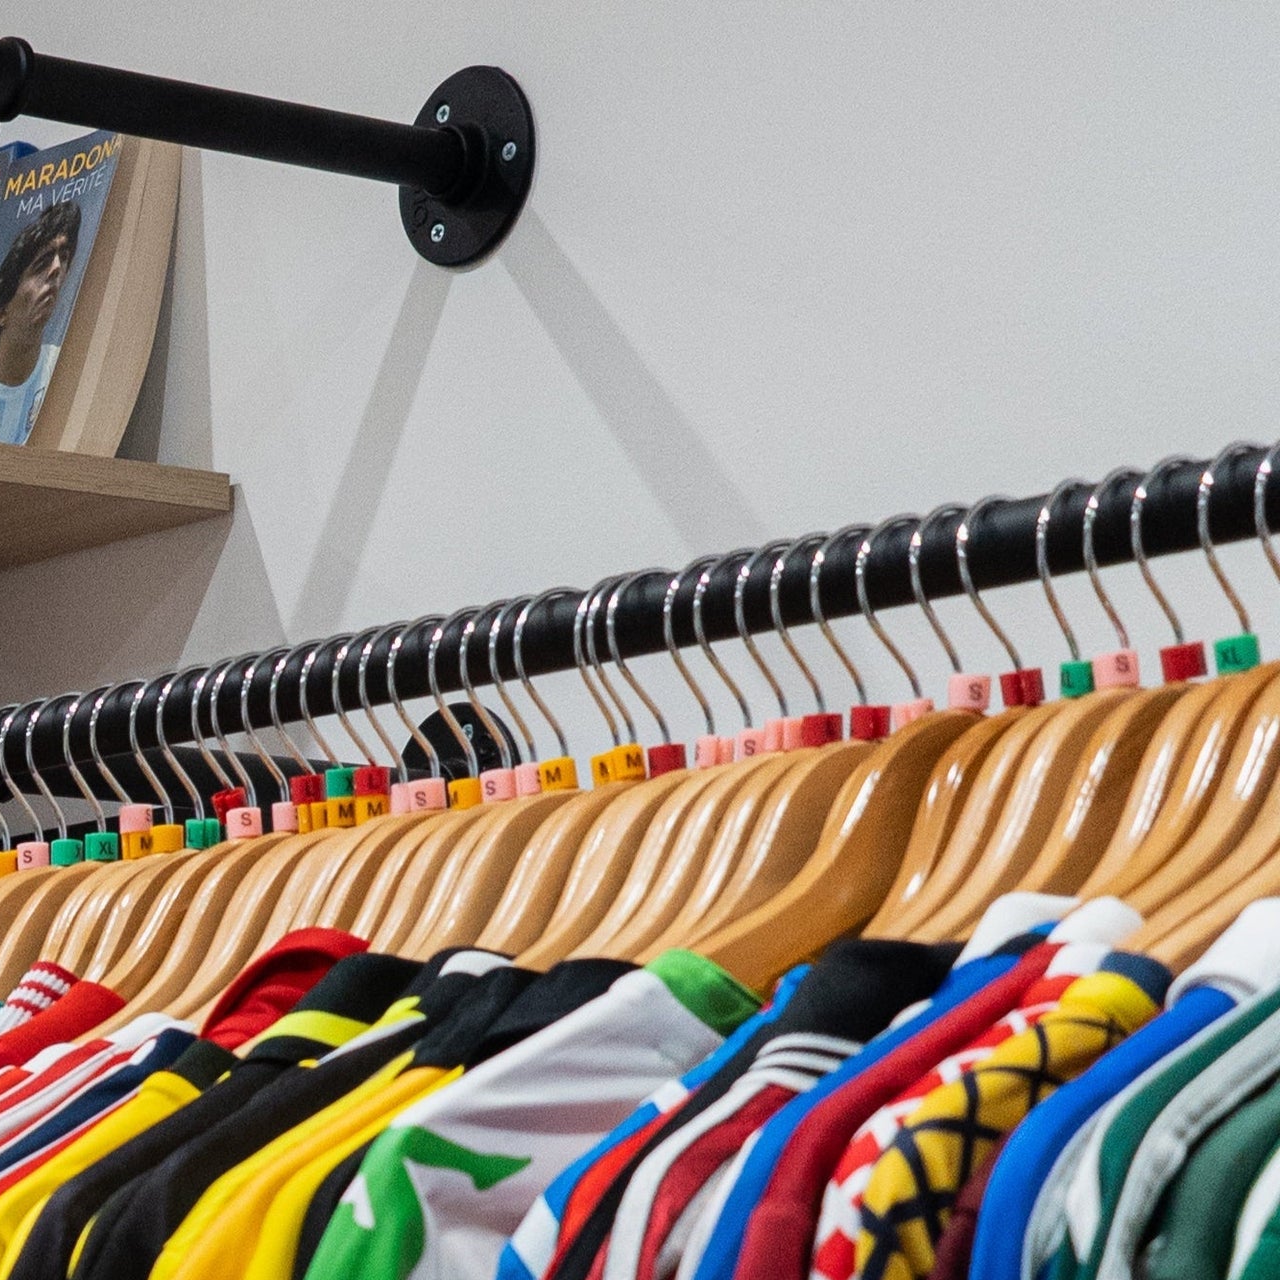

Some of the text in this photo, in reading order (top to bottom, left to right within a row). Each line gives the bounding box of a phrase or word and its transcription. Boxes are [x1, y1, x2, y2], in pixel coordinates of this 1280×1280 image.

[16, 193, 43, 219] MA
[1115, 653, 1130, 674] S
[968, 682, 983, 700] S
[744, 740, 756, 756] S
[546, 766, 563, 785] M
[485, 780, 496, 796] S
[415, 791, 427, 807] S
[339, 802, 355, 819] M
[367, 801, 383, 817] M
[241, 812, 253, 827] S
[99, 840, 115, 856] XL
[23, 850, 33, 864] S
